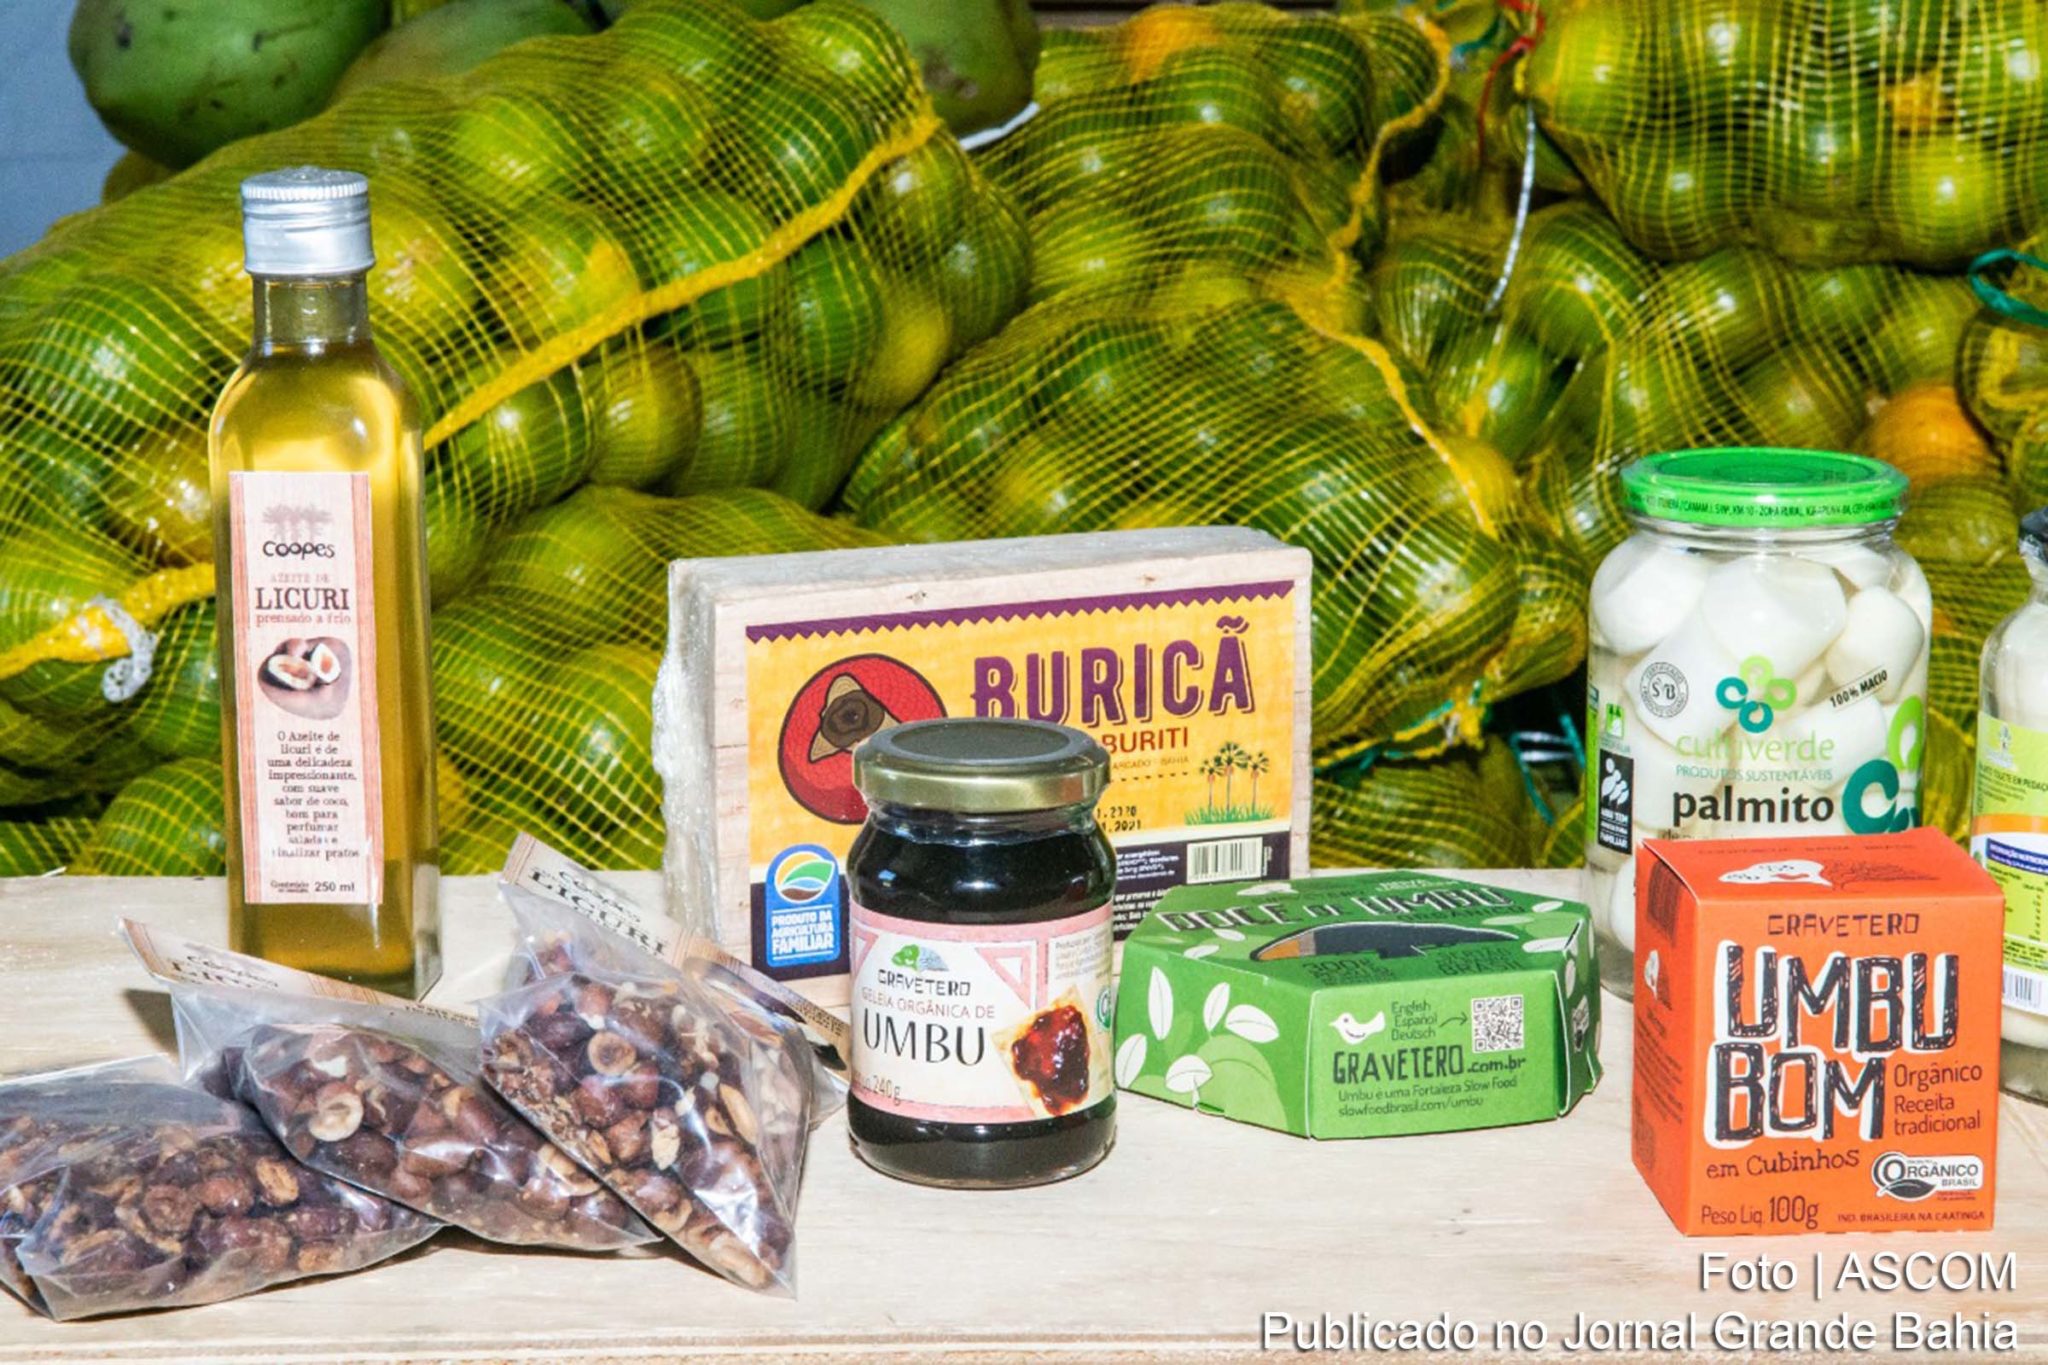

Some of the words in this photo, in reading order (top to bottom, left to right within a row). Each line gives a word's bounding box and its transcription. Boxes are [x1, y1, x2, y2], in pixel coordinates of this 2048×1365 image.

[255, 587, 350, 611] LICURI
[256, 613, 312, 628] prensado
[316, 615, 323, 623] a
[327, 612, 351, 624] frio
[970, 615, 1255, 727] BURICÃ
[1830, 687, 1860, 708] 100%
[1860, 669, 1888, 694] MACIO
[289, 731, 324, 742] Azeite
[327, 731, 340, 741] de
[1102, 726, 1188, 754] BURITI
[1675, 729, 1835, 762] cultiverde
[325, 744, 338, 754] de
[267, 758, 291, 767] uma
[295, 757, 352, 768] delicadeza
[1676, 764, 1744, 781] PRODUTOS
[1746, 768, 1833, 782] SUSTENTÁVEIS
[282, 785, 304, 793] com
[308, 785, 339, 793] suave
[274, 797, 302, 806] sabor
[306, 797, 320, 806] de
[1673, 785, 1835, 828] palmito
[286, 809, 308, 819] bom
[313, 811, 338, 823] para
[286, 822, 339, 835] perfumar
[331, 837, 338, 845] e
[325, 848, 359, 861] pratos
[315, 882, 336, 892] 250
[340, 882, 355, 892] ml
[772, 911, 817, 926] PRODUTO
[819, 909, 832, 922] DA
[1768, 913, 1919, 937] GRAVETERO
[772, 933, 835, 956] FAMILIAR
[877, 969, 972, 996] GRAVETERO
[861, 987, 894, 1009] GELEIA
[896, 995, 970, 1019] ORGÂNICA
[975, 1006, 996, 1019] DE
[1716, 940, 1959, 1054] UMBU
[1391, 1000, 1431, 1016] English
[1394, 1013, 1438, 1029] Español
[863, 1007, 985, 1067] UMBU
[1391, 1027, 1436, 1041] Deutsch
[1894, 1063, 1982, 1092] Orgânico
[1338, 1088, 1374, 1102] Umbu
[1384, 1089, 1410, 1099] uma
[1412, 1083, 1462, 1097] Fortaleza
[1464, 1078, 1489, 1092] Slow
[1492, 1076, 1518, 1090] Food
[1706, 1042, 1887, 1144] BOM
[1339, 1097, 1484, 1118] slowfoodbrasil.com/umbu
[1894, 1095, 1955, 1115] Receita
[1894, 1110, 1981, 1136] tradicional
[1706, 1163, 1739, 1179] em
[1746, 1149, 1860, 1176] Cubinhos
[1883, 1159, 1979, 1182] ORGÂNICO
[1941, 1179, 1978, 1187] BRASIL
[1702, 1205, 1736, 1225] Peso
[1769, 1195, 1820, 1230] 100g
[1860, 1212, 1916, 1222] BRASILEIRA
[1919, 1212, 1933, 1221] NA
[1935, 1210, 1985, 1221] CAATINGA
